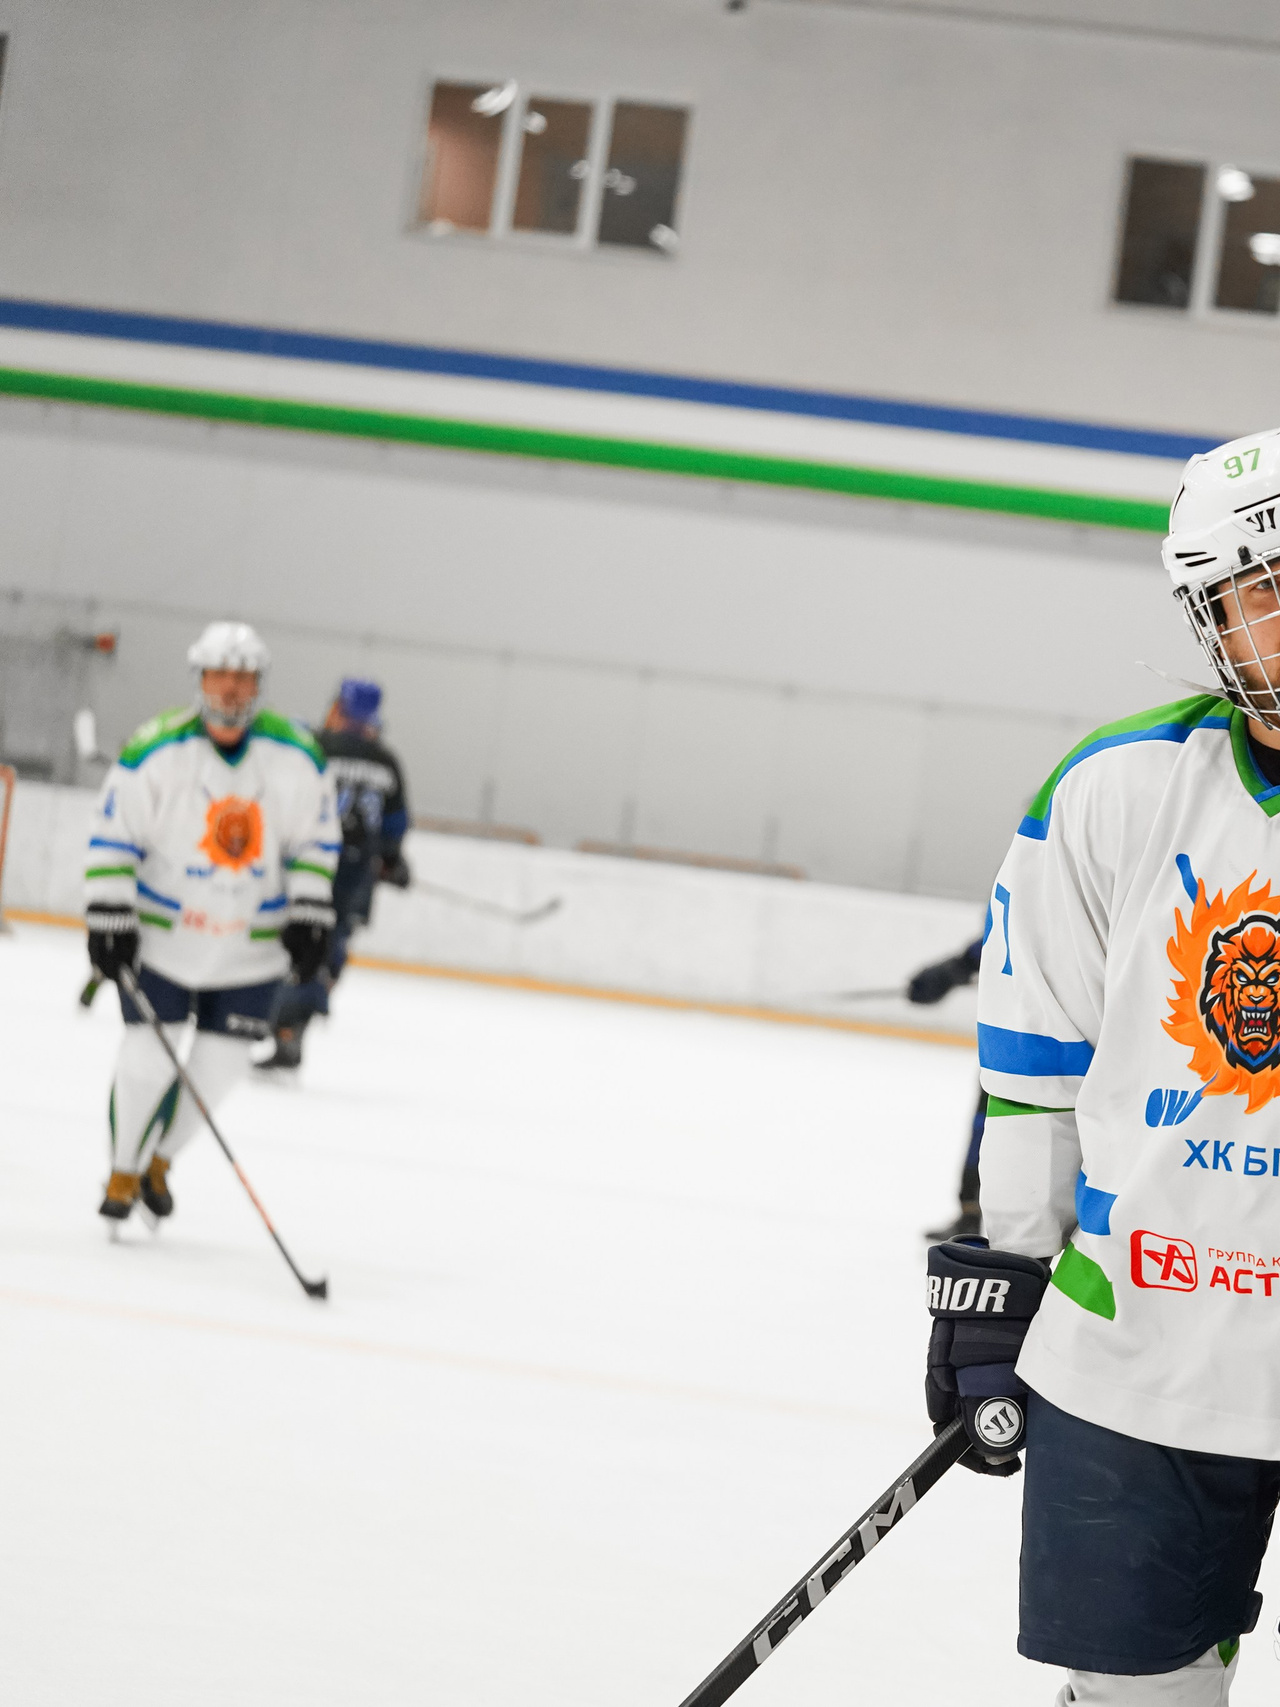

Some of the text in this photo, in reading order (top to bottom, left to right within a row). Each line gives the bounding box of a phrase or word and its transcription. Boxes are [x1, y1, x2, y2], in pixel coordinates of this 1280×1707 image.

[1223, 448, 1261, 479] 97
[1182, 1139, 1235, 1172] ХК
[1208, 1247, 1266, 1268] ГРУППА
[926, 1274, 1011, 1312] RIOR
[753, 1477, 917, 1665] CCM
